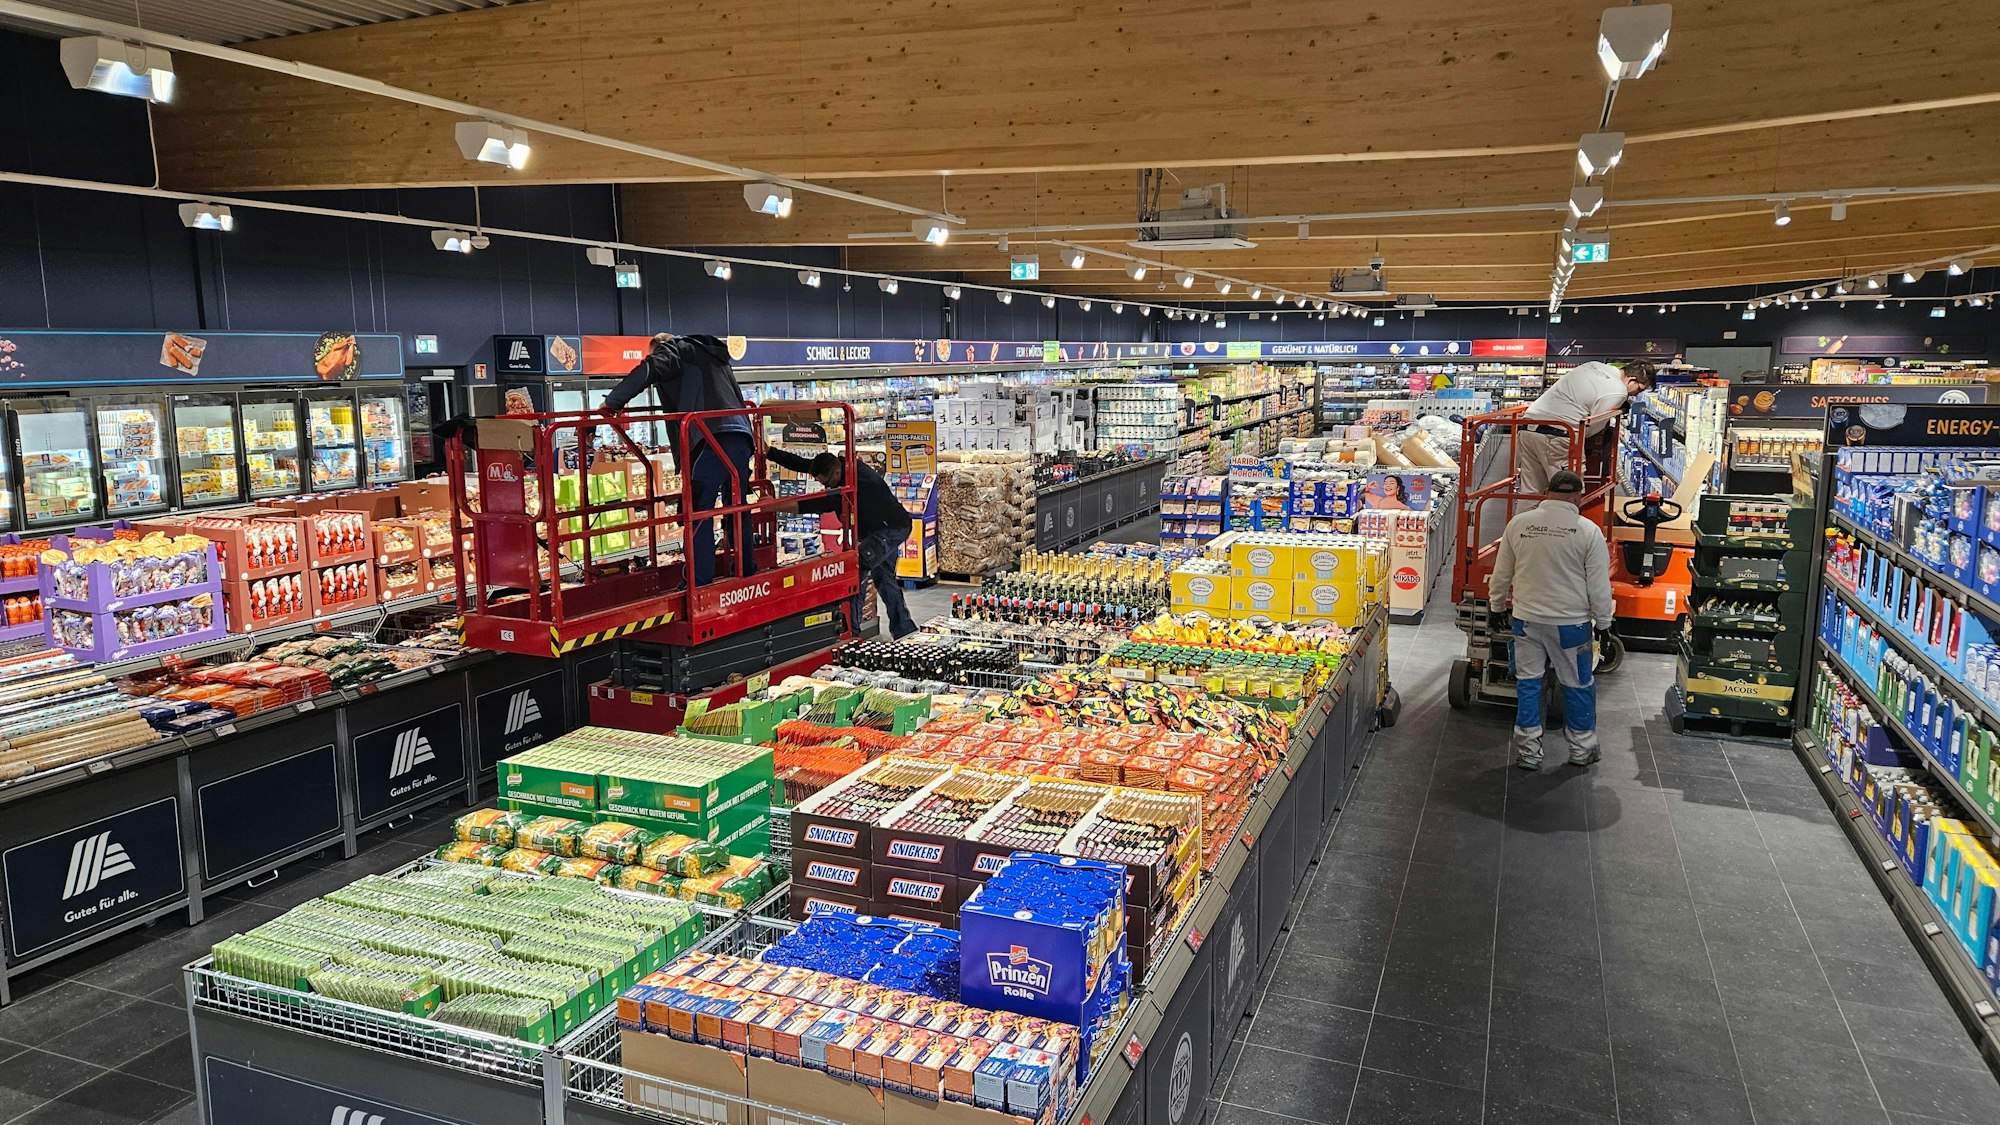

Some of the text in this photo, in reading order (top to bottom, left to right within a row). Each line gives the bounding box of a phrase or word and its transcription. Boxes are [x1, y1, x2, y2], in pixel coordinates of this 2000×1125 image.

[622, 350, 643, 360] AKTION
[806, 346, 871, 361] SCHNELL & LECKER
[1272, 344, 1358, 354] GEKÜHLT & NATÜRLICH
[1232, 457, 1259, 466] HARIBO
[1410, 493, 1422, 501] jetzt
[811, 561, 845, 582] MAGNI
[1393, 574, 1421, 583] MIKADO
[720, 582, 770, 608] ES0807AC
[503, 632, 512, 640] CE
[1722, 686, 1758, 694] JACOBS
[390, 774, 438, 797] Gutes für alle.
[568, 786, 586, 794] SAUCEN
[507, 790, 537, 801] GESCHMACK
[536, 794, 546, 802] MIT
[546, 796, 562, 805] GUTEM
[672, 799, 690, 807] SAUCEN
[706, 798, 732, 820] GESCHMACK
[732, 794, 740, 806] MIT
[740, 786, 754, 801] GUTEM
[608, 803, 638, 814] GESCHMACK
[638, 807, 648, 816] MIT
[649, 808, 666, 818] GUTEM
[808, 827, 854, 845] SNICKERS
[891, 842, 940, 860] SNICKERS
[978, 856, 1006, 872] SNIC
[810, 864, 856, 883] SNICKERS
[891, 881, 940, 900] SNICKERS
[64, 890, 139, 923] Gutes für alle.
[992, 960, 1046, 988] Prinzen
[1004, 986, 1035, 1000] Rolle
